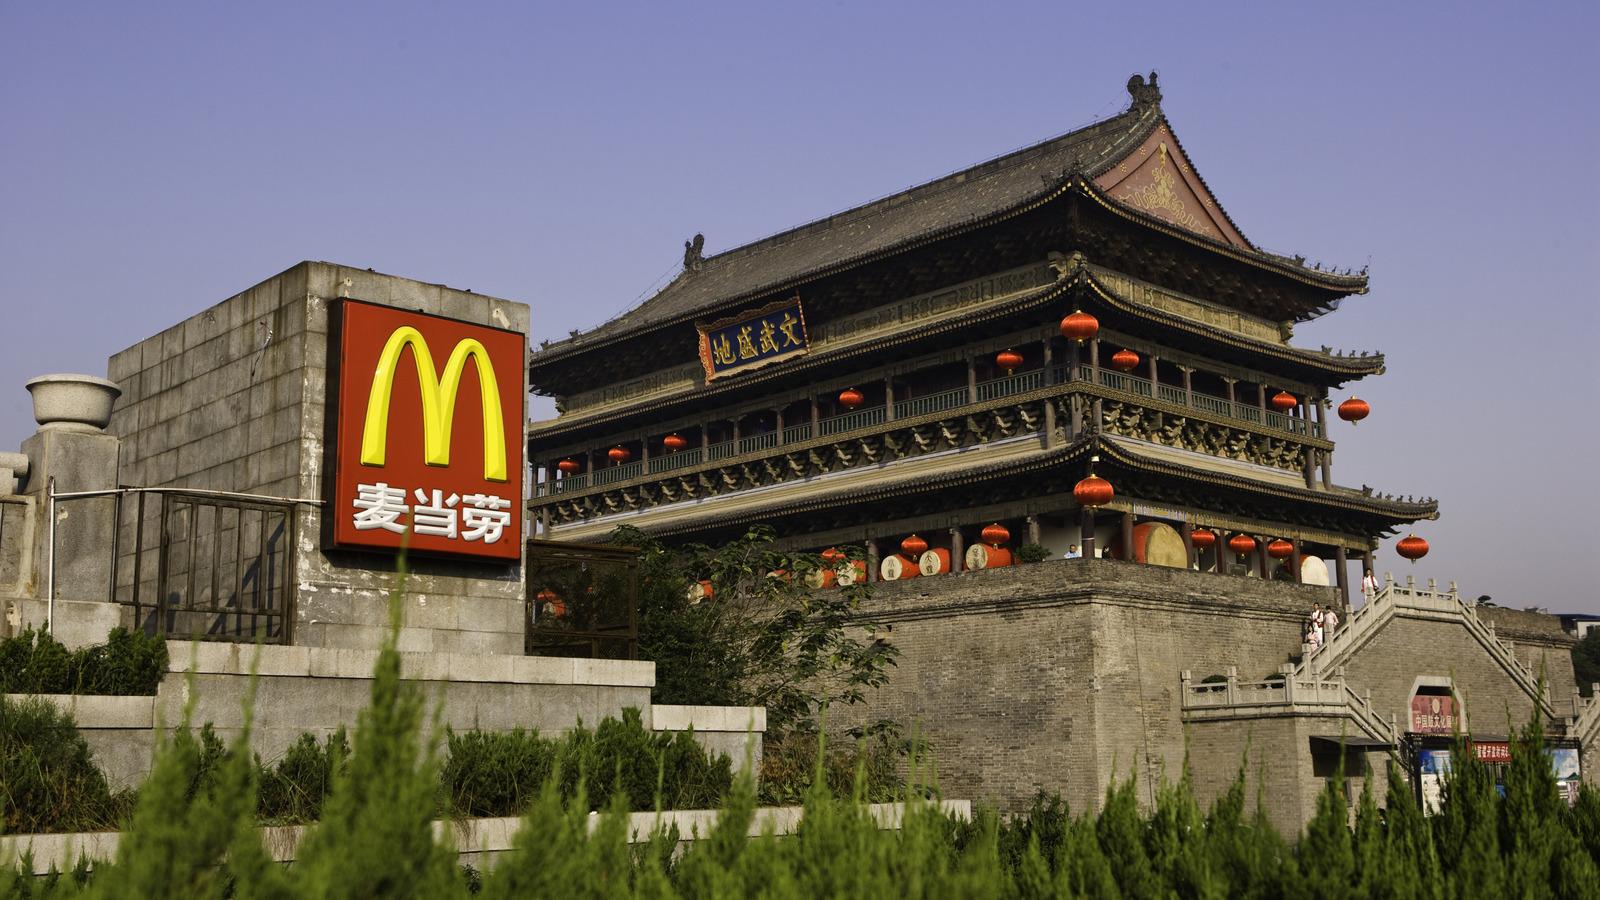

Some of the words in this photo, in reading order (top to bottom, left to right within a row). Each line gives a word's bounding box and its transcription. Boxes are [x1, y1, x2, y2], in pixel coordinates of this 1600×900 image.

[360, 325, 508, 483] M
[353, 482, 512, 544] 麦当劳
